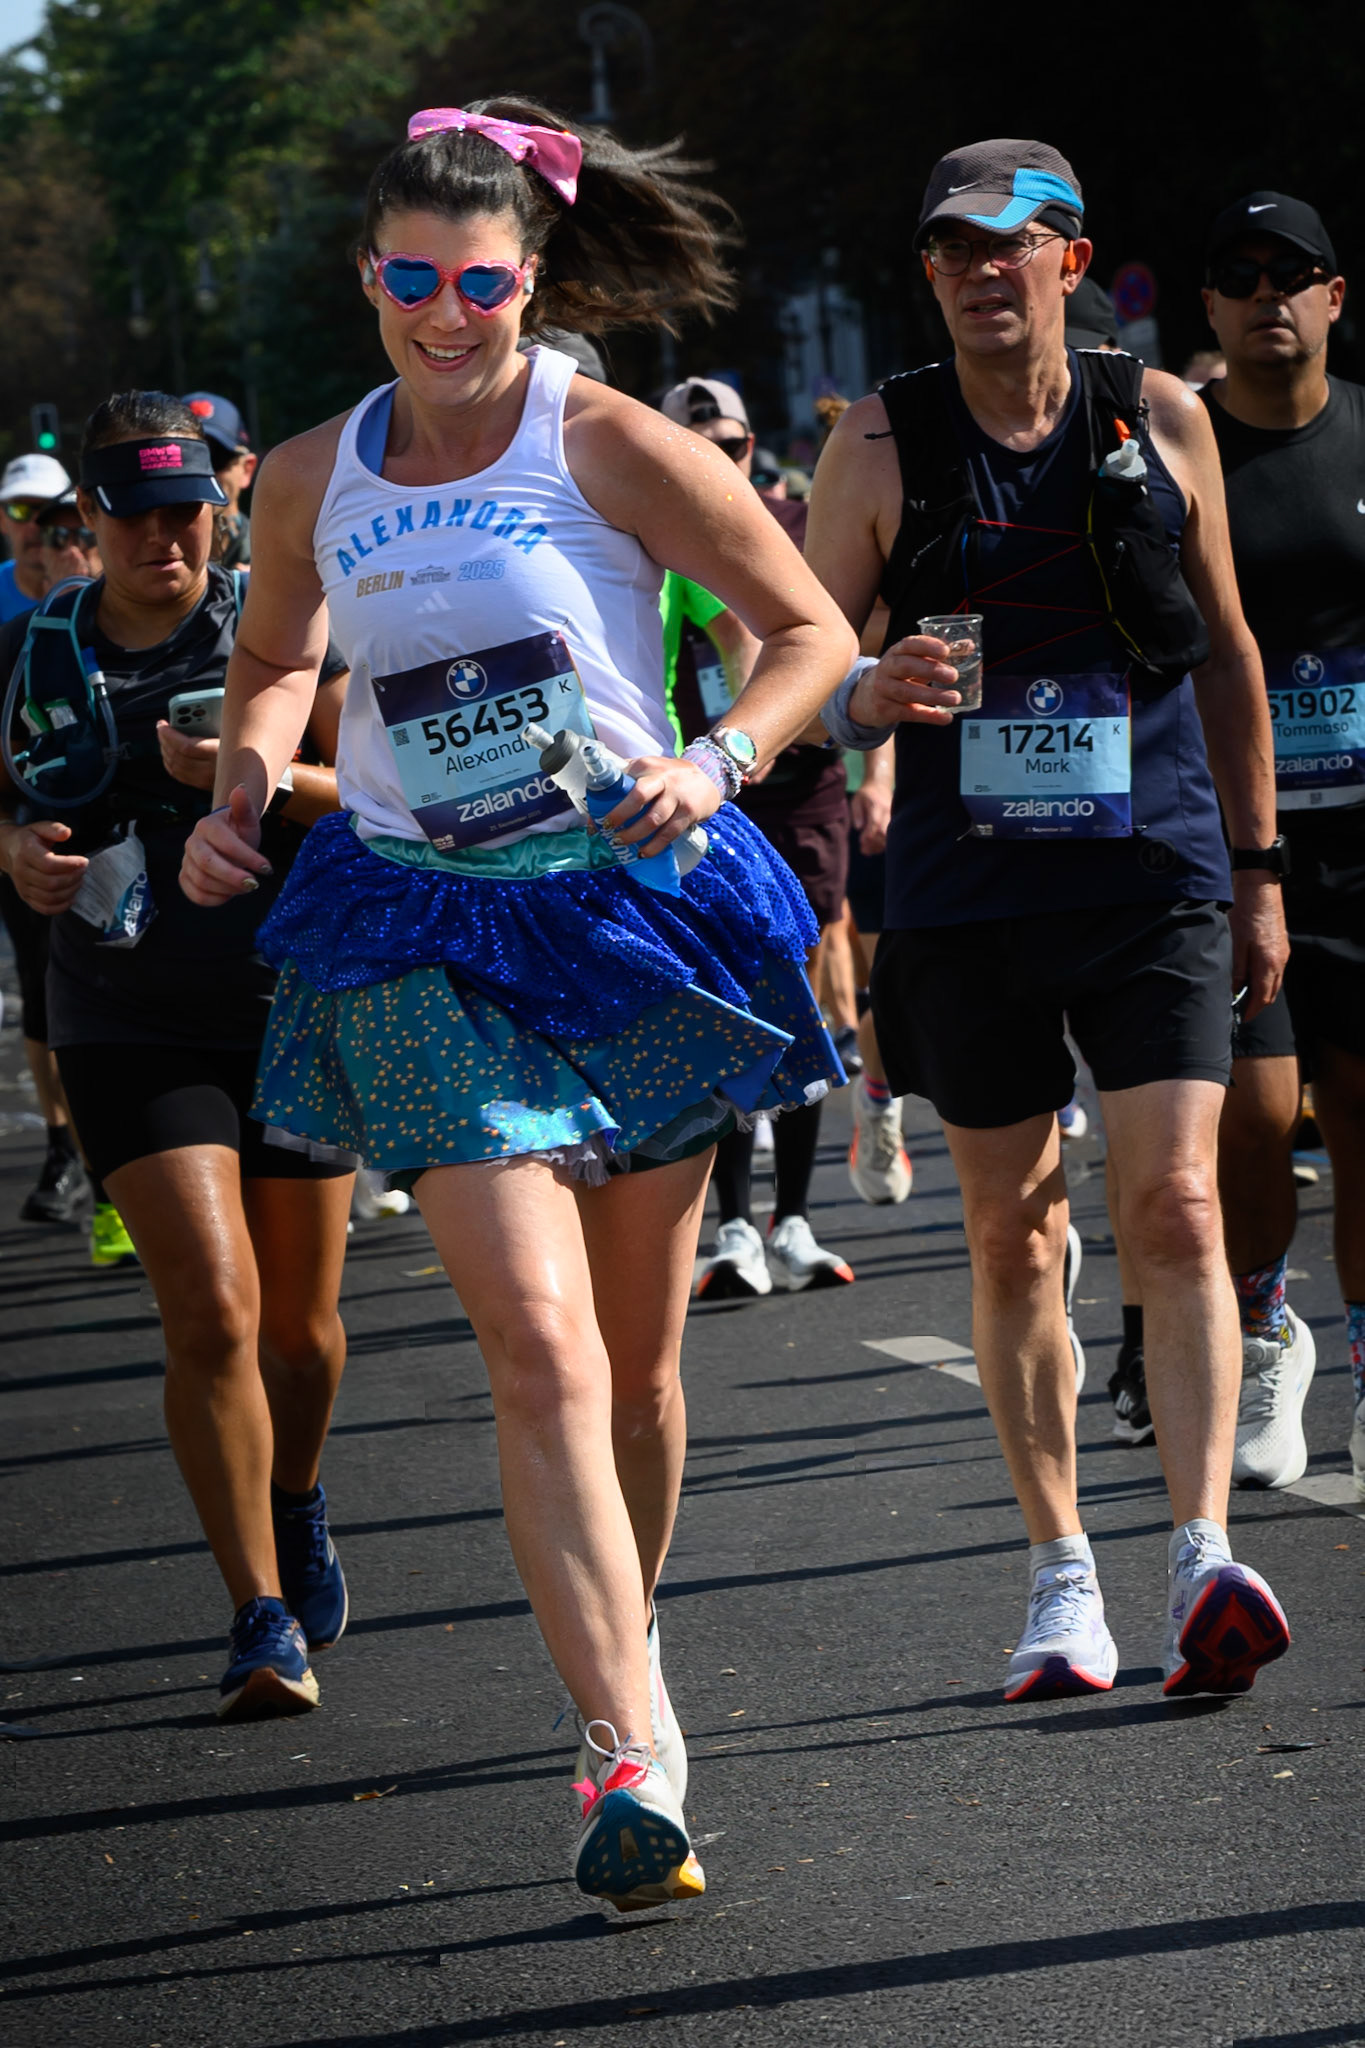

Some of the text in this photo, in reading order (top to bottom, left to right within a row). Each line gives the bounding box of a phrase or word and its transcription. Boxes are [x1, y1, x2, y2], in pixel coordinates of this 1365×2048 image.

[336, 499, 549, 577] ALEXANDRA
[356, 560, 506, 598] BERLIN 2025
[558, 679, 573, 694] K
[1266, 688, 1357, 720] 51902
[421, 687, 550, 756] 56453
[1112, 723, 1121, 735] K
[1274, 721, 1349, 738] Tommaso
[998, 723, 1094, 754] 17214
[1025, 758, 1071, 774] Mark
[1275, 754, 1353, 774] zalando
[456, 777, 558, 823] zalando
[1002, 798, 1095, 818] zalando
